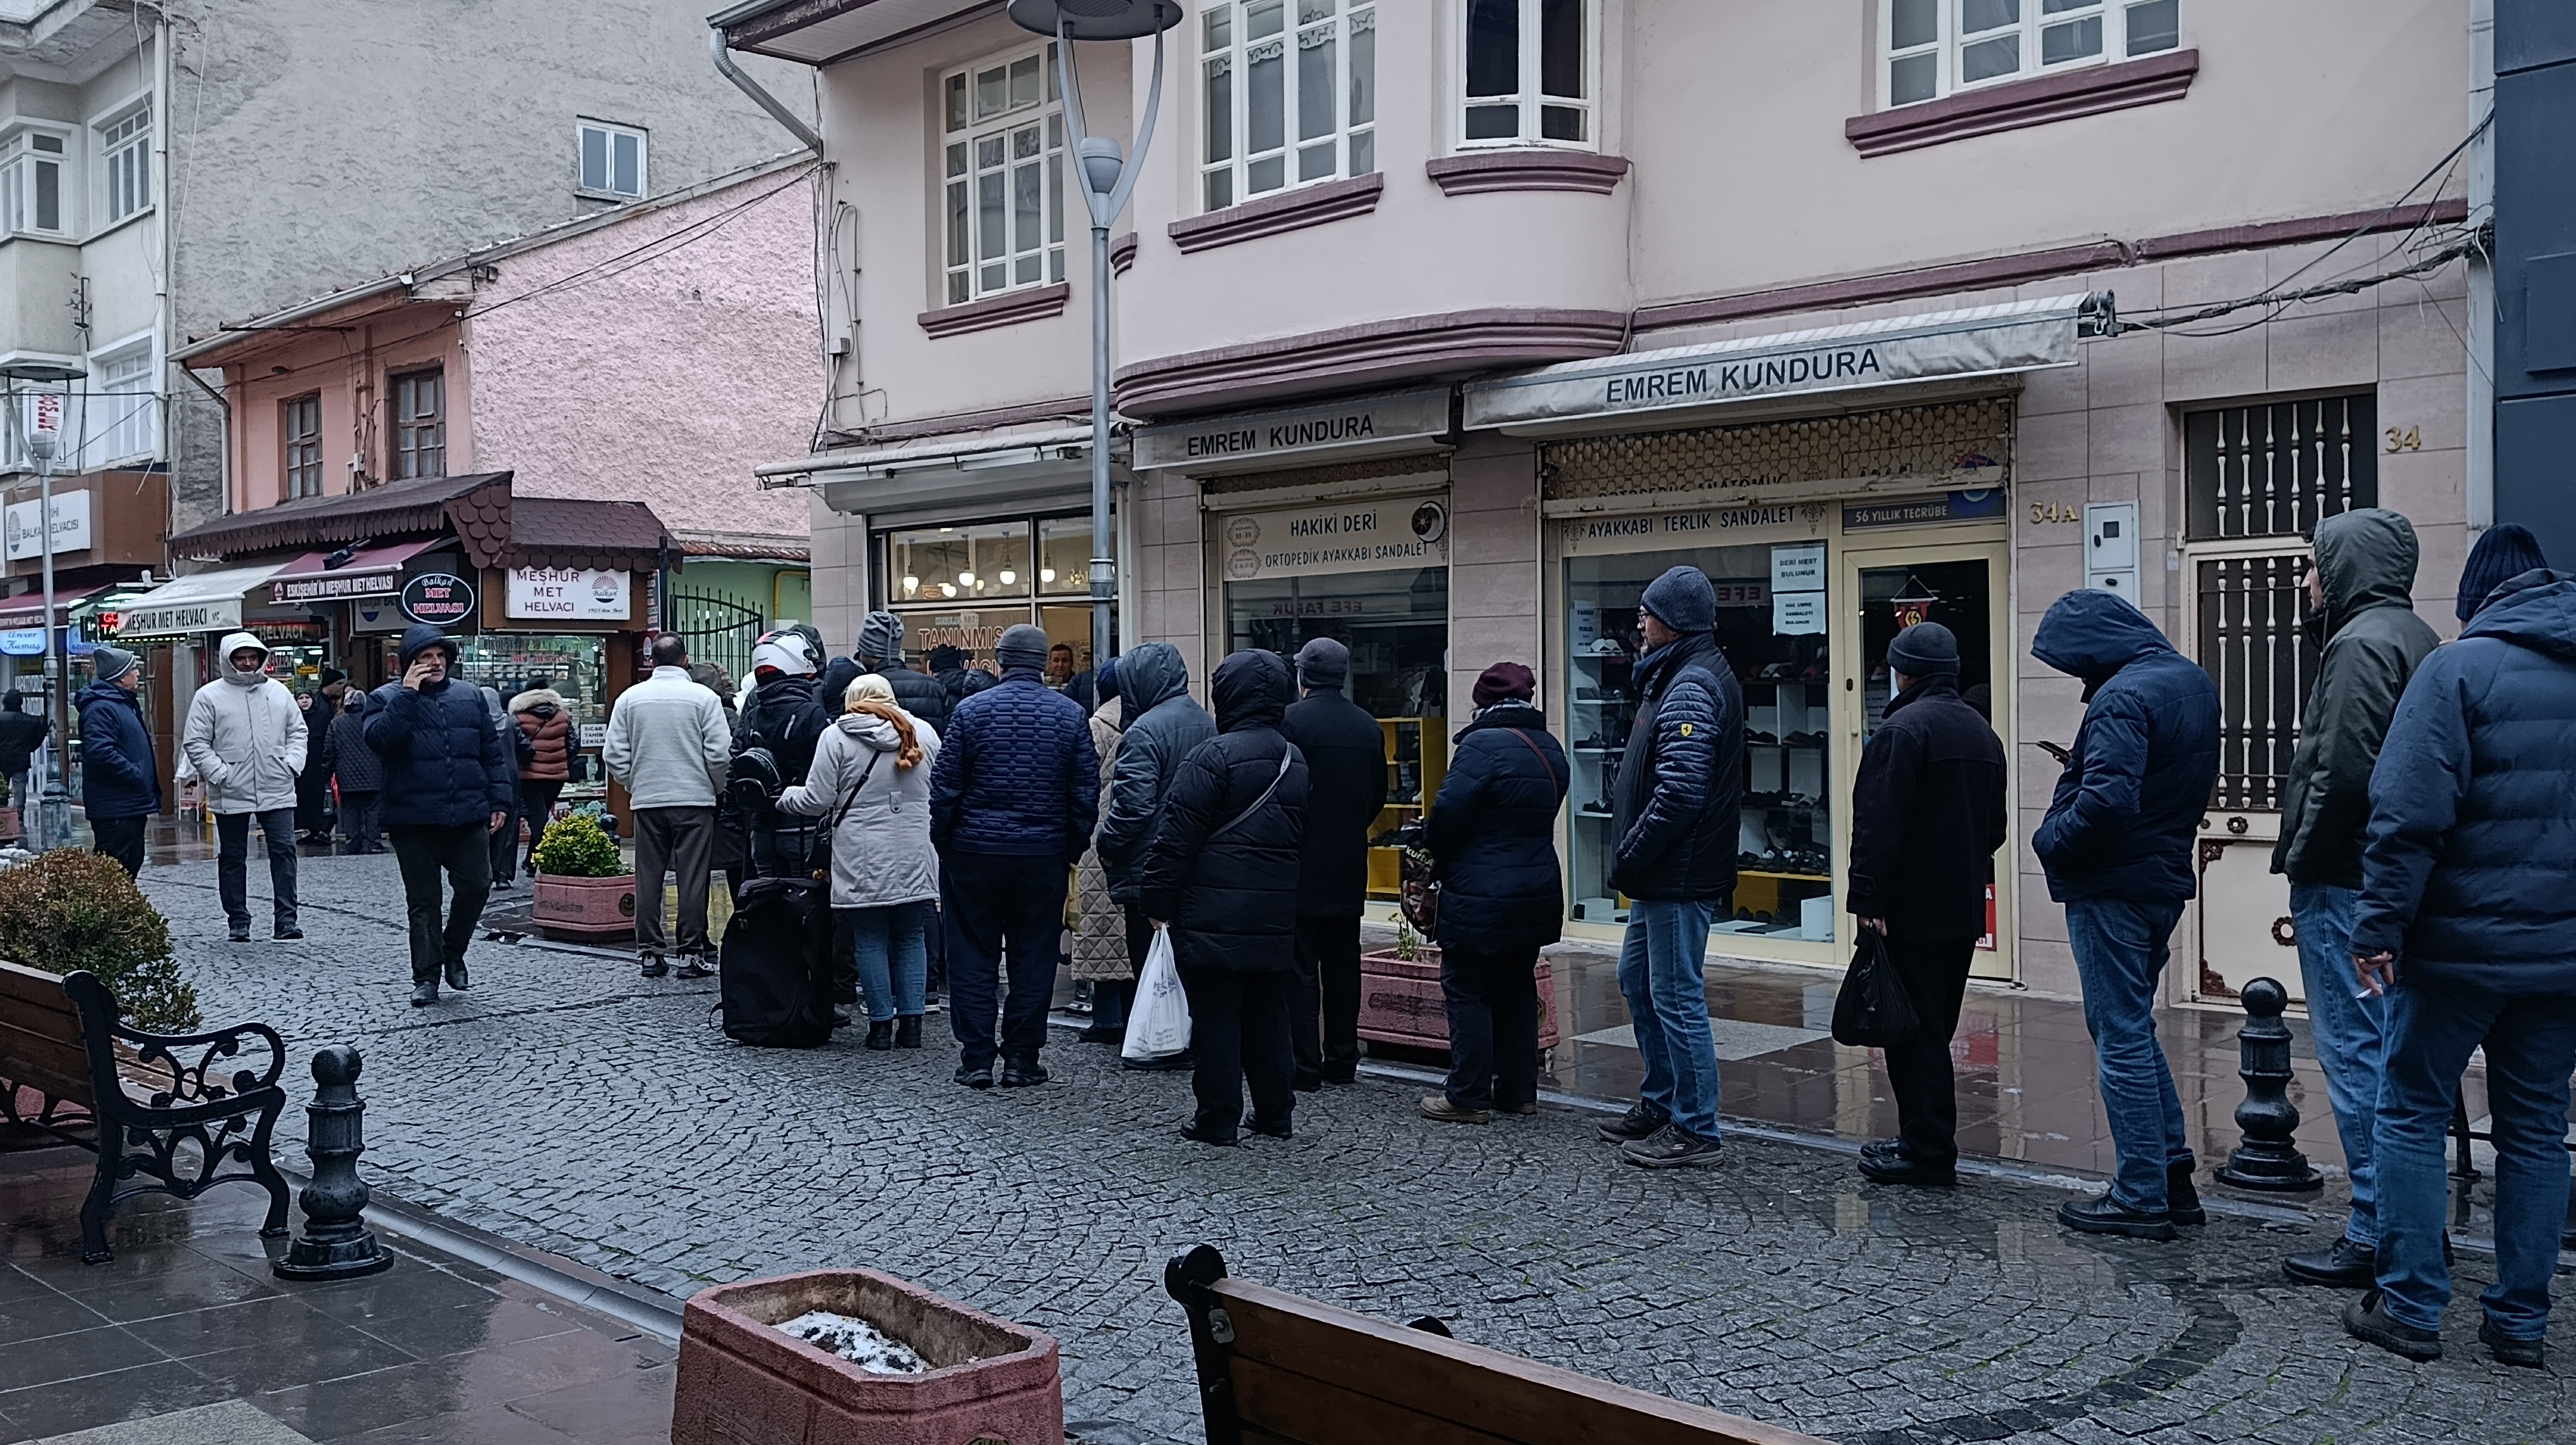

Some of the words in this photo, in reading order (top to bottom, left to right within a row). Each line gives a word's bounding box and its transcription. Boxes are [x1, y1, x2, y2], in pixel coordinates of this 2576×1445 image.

[1606, 369, 1707, 402] EMREM
[1722, 349, 1880, 391] KUNDURA
[1188, 429, 1256, 457] EMREM
[1270, 414, 1374, 448] KUNDURA
[2385, 424, 2421, 453] 34
[1291, 512, 1338, 537] HAKİKİ
[1344, 508, 1377, 533] DERİ
[1588, 517, 1654, 538] AYAKKABI
[1664, 510, 1711, 532] TERLİK
[1720, 506, 1796, 528] SANDALET
[1855, 510, 1869, 524] 56
[1871, 508, 1901, 522] YILLIK
[1903, 505, 1948, 520] TECRÜBE
[2030, 500, 2079, 525] 34A
[22, 525, 42, 539] BALKA
[50, 519, 79, 534] ELVACISI
[1265, 548, 1320, 568] ORTOPEDİK
[1322, 546, 1371, 564] AYAKKABI
[1374, 541, 1428, 560] SANDALET
[1779, 558, 1796, 567] DERİ
[516, 571, 580, 585] MEŞHUR
[1781, 569, 1816, 578] BULUNUR
[326, 579, 352, 597] MEŞHUR
[366, 575, 393, 592] HELVASI
[425, 587, 451, 599] MET
[534, 587, 564, 597] MET
[413, 602, 465, 614] HELVASI
[525, 602, 575, 612] HELVACI
[158, 610, 174, 629] MET
[176, 607, 207, 627] HELVACI
[259, 624, 303, 641] HELVACI
